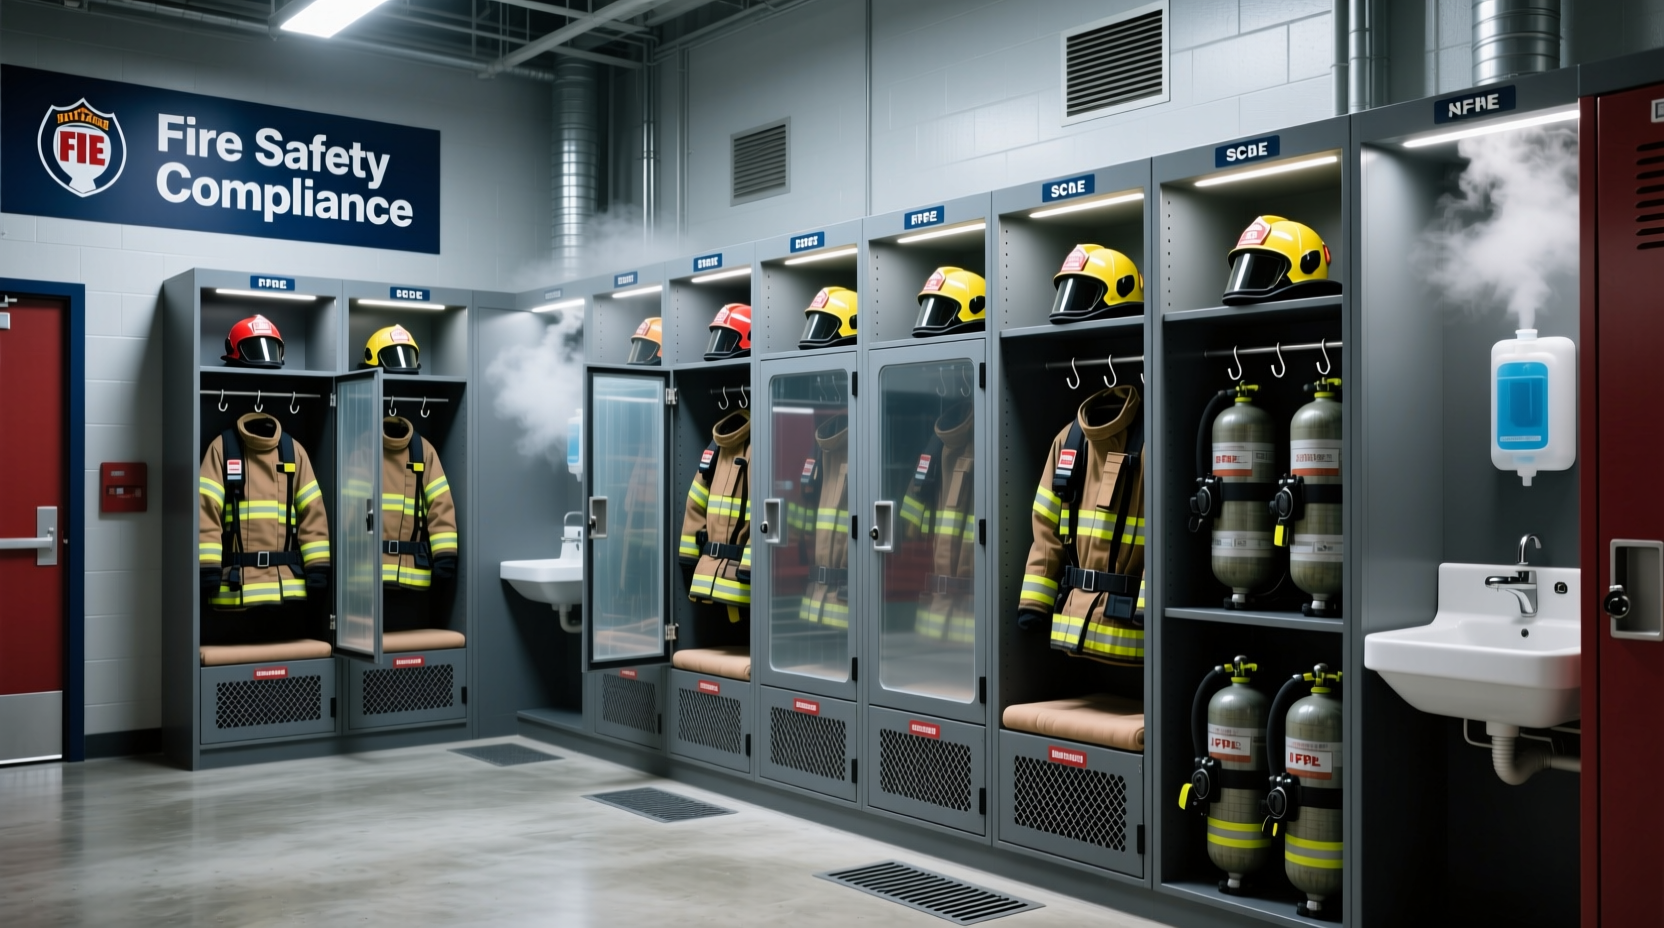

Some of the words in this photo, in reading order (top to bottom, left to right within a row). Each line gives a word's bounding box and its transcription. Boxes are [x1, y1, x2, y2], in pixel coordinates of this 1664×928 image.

[59, 130, 106, 166] FIE
[158, 113, 243, 162] Fire
[255, 127, 390, 190] Safety
[156, 162, 414, 228] Compliance
